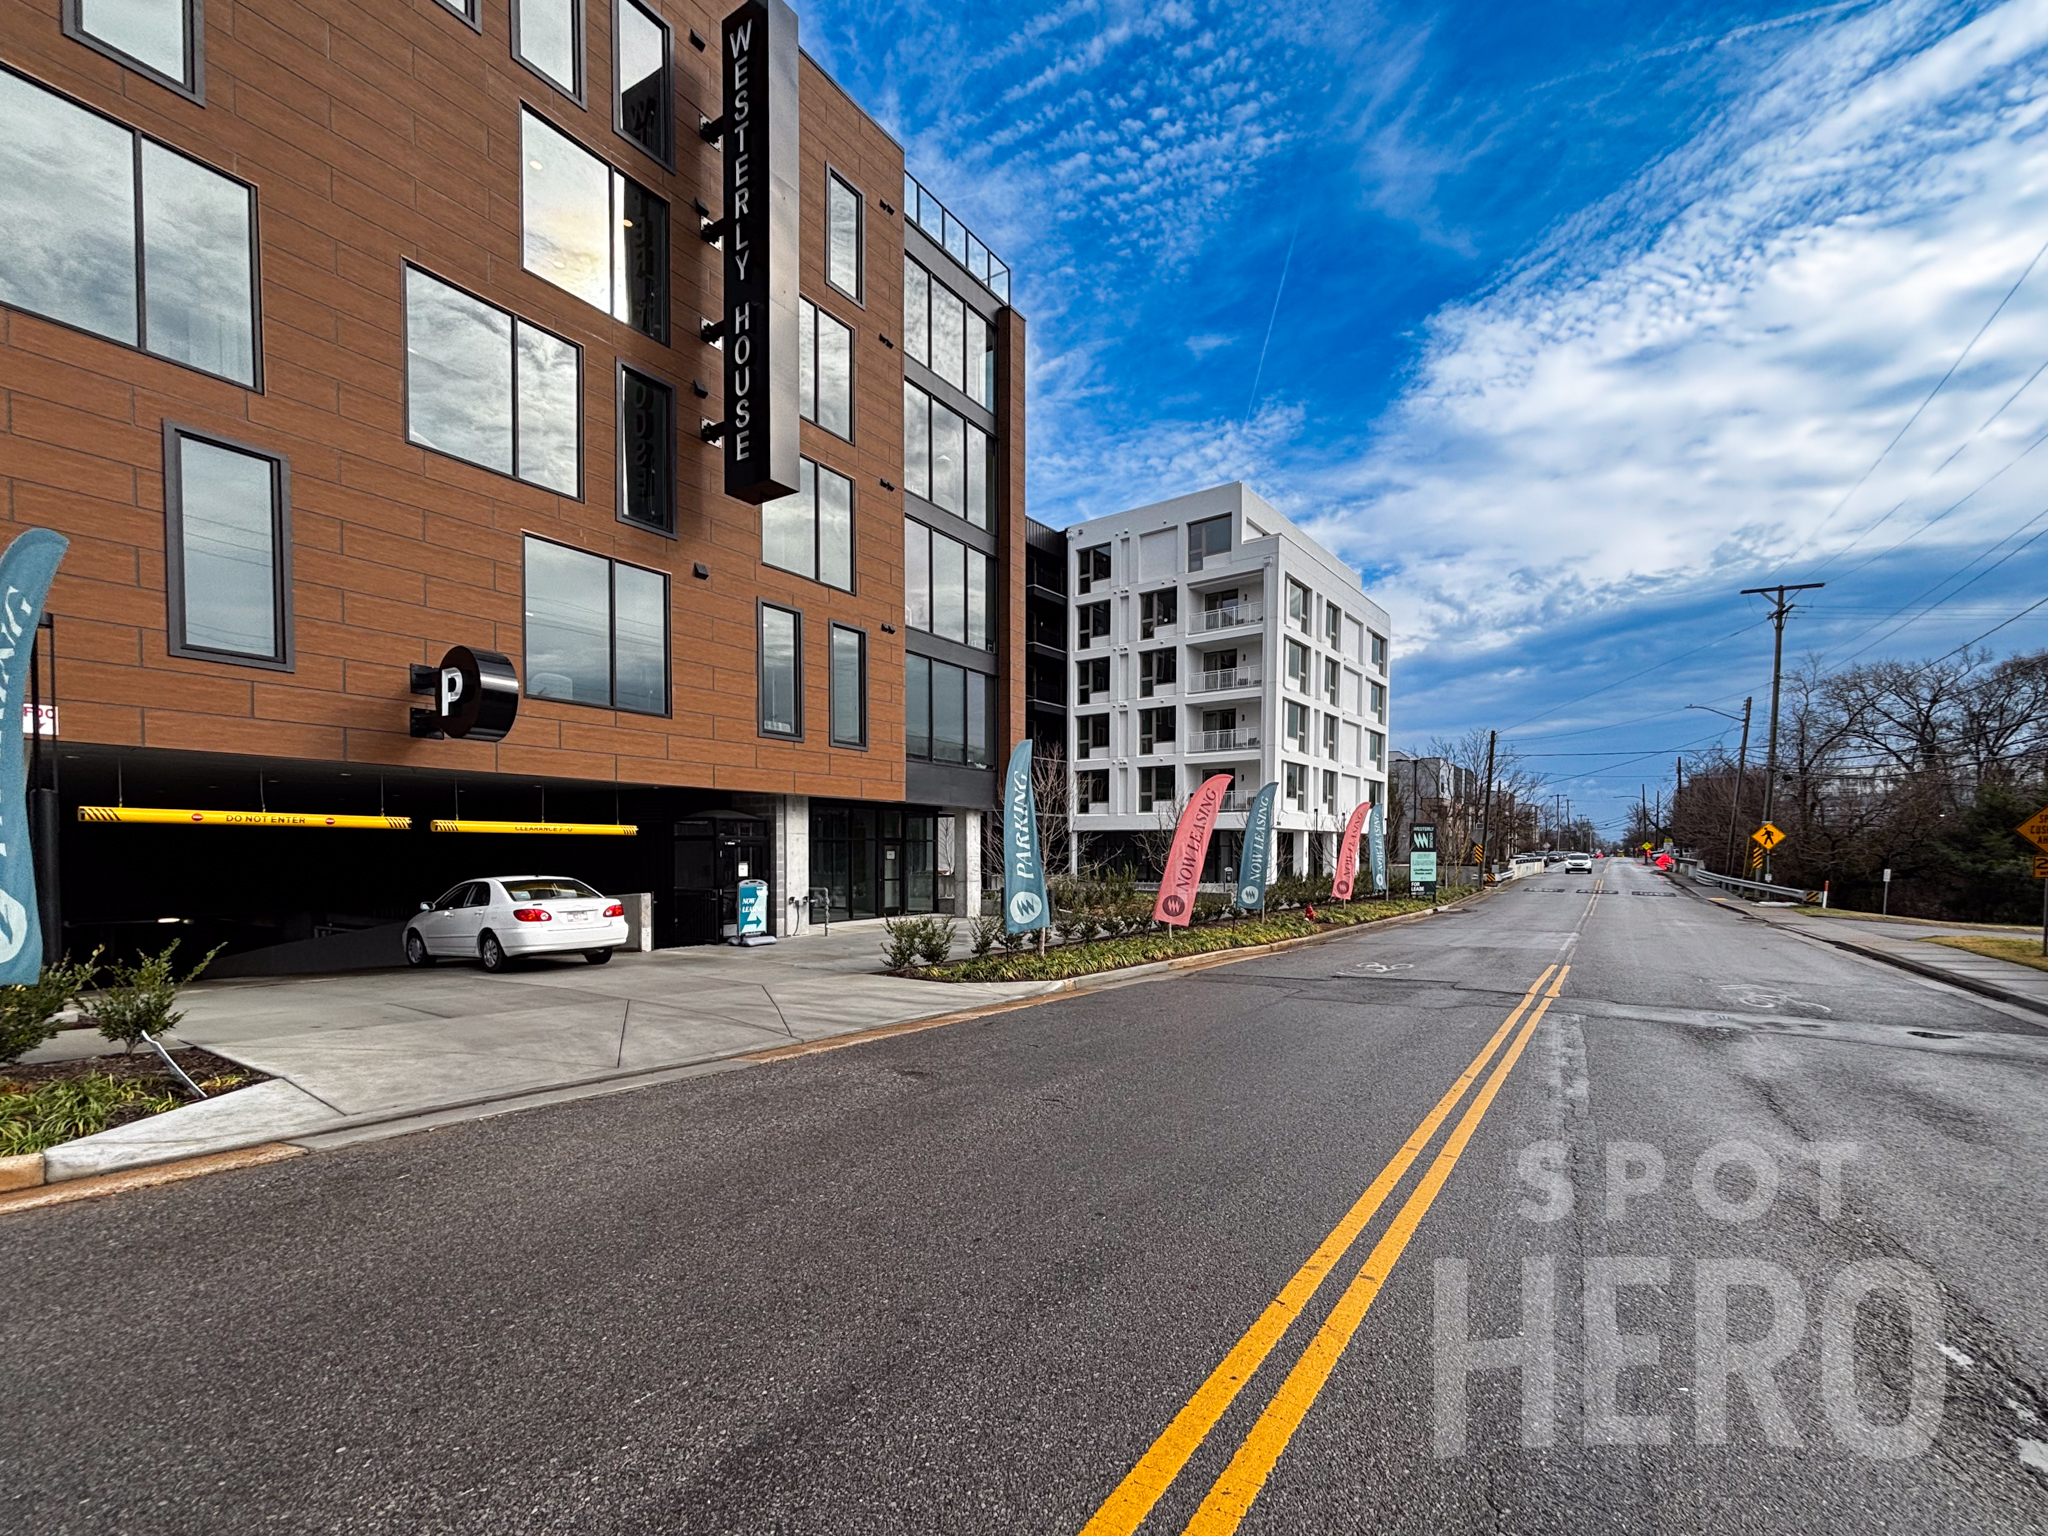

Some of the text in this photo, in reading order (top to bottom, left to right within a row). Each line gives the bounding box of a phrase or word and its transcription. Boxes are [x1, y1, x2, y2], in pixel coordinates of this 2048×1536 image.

[729, 18, 753, 462] WESTERLY HOUSE
[441, 666, 464, 717] P
[226, 814, 306, 824] DO NOT ENTER
[1013, 770, 1035, 879] PARKING
[1176, 787, 1217, 892] NOW LEASING
[1250, 795, 1269, 882] NOW LEASING
[2030, 825, 2048, 834] CUS
[742, 897, 756, 905] NOW
[742, 905, 764, 914] LEASING
